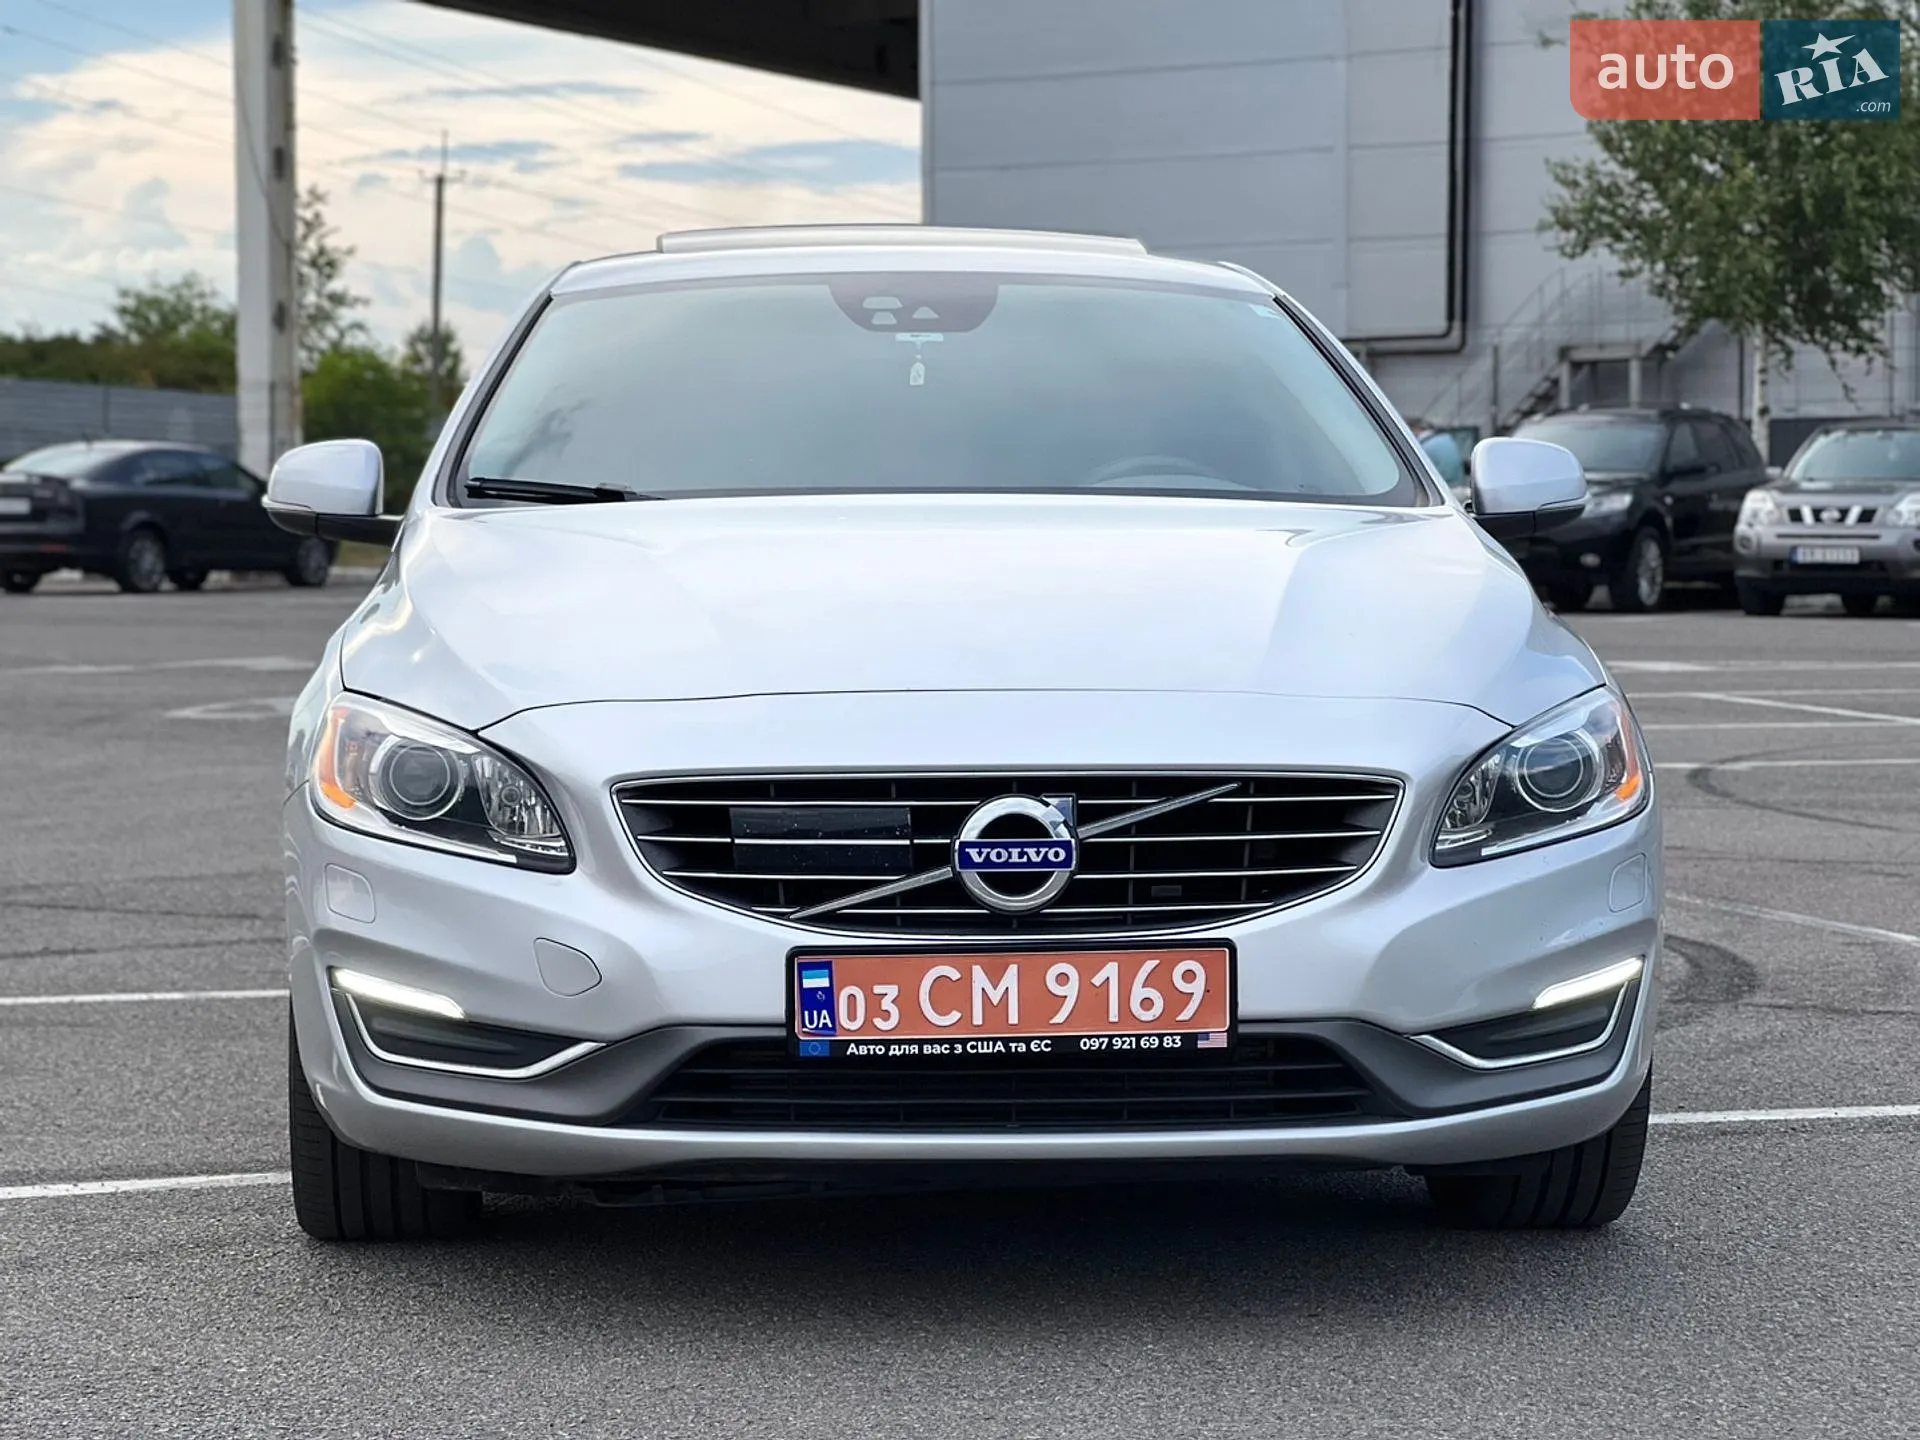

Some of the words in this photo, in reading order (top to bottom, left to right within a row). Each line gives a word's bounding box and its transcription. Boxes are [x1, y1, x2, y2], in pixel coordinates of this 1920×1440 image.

[964, 847, 1067, 863] VOLVO
[838, 984, 900, 1032] 03
[1044, 959, 1207, 1025] 9169
[804, 1009, 833, 1029] UA
[846, 1042, 886, 1056] Авто
[889, 1043, 919, 1057] для
[923, 1043, 950, 1055] вас
[953, 1043, 963, 1055] з
[966, 1041, 1006, 1054] США
[1009, 1041, 1027, 1053] та
[1030, 1039, 1052, 1053] ЄС
[1079, 1037, 1109, 1050] 097
[1112, 1036, 1136, 1049] 921
[1140, 1036, 1159, 1049] 69
[1162, 1035, 1182, 1048] 83
